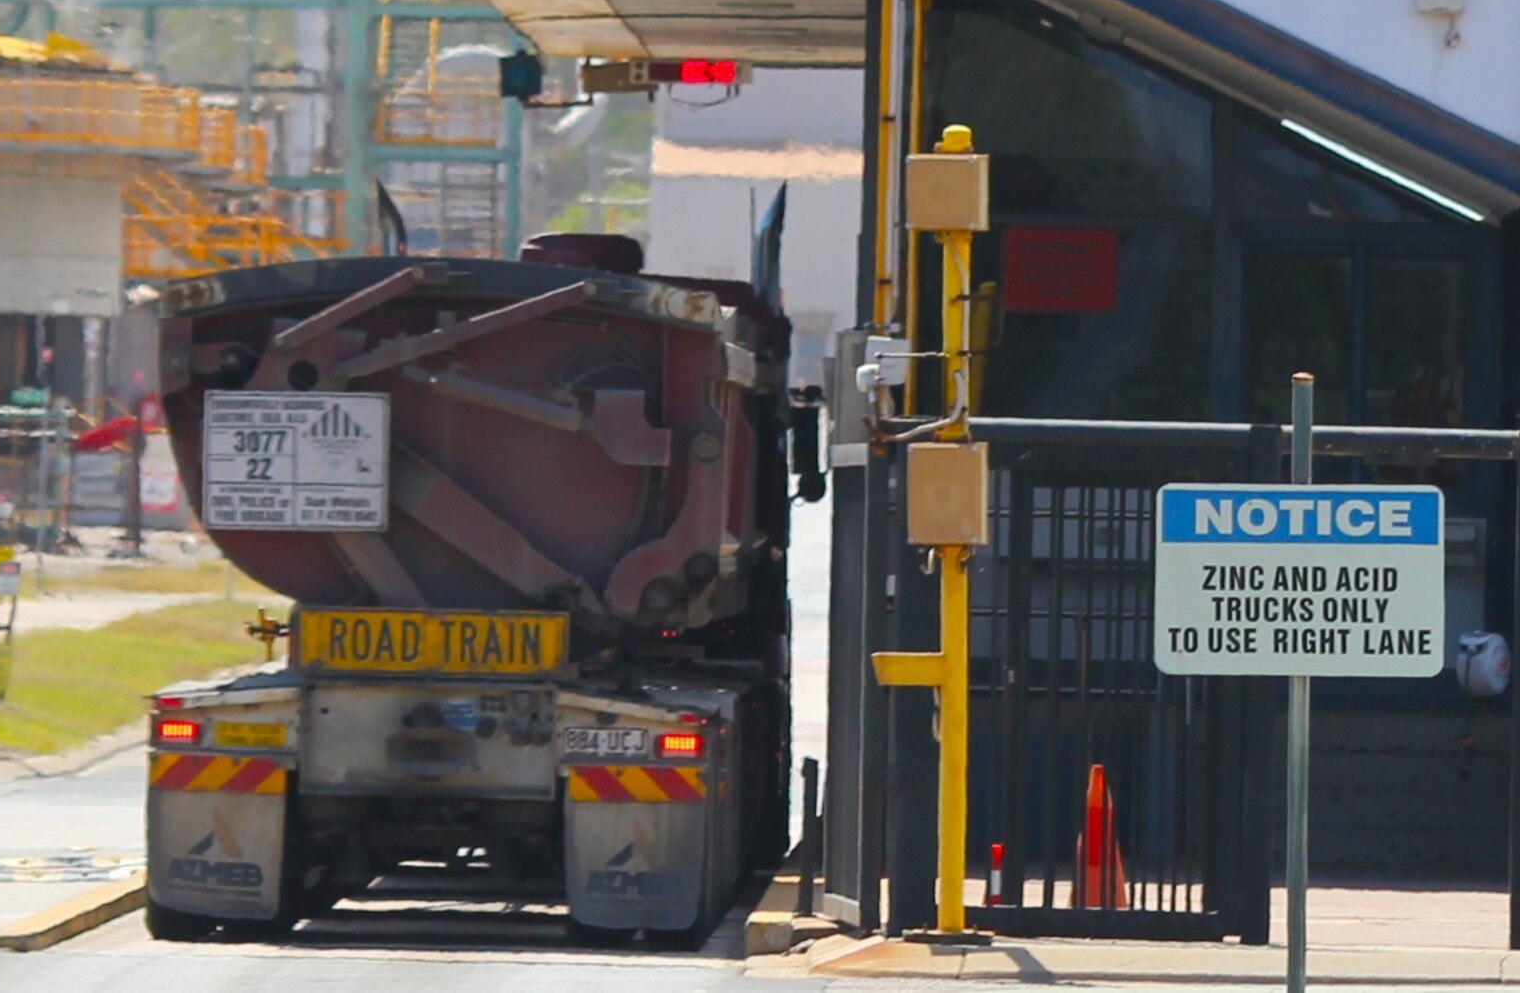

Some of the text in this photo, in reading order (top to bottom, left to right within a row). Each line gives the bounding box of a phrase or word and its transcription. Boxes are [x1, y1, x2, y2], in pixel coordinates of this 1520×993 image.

[233, 431, 287, 453] 3077
[246, 459, 272, 480] 2Z
[1193, 498, 1413, 538] NOTICE
[1201, 565, 1398, 593] ZINC AND ACID
[1211, 596, 1390, 624] TRUCKS ONLY
[330, 617, 541, 665] ROAD TRAIN
[1168, 627, 1432, 655] TO USE RIGHT LANE
